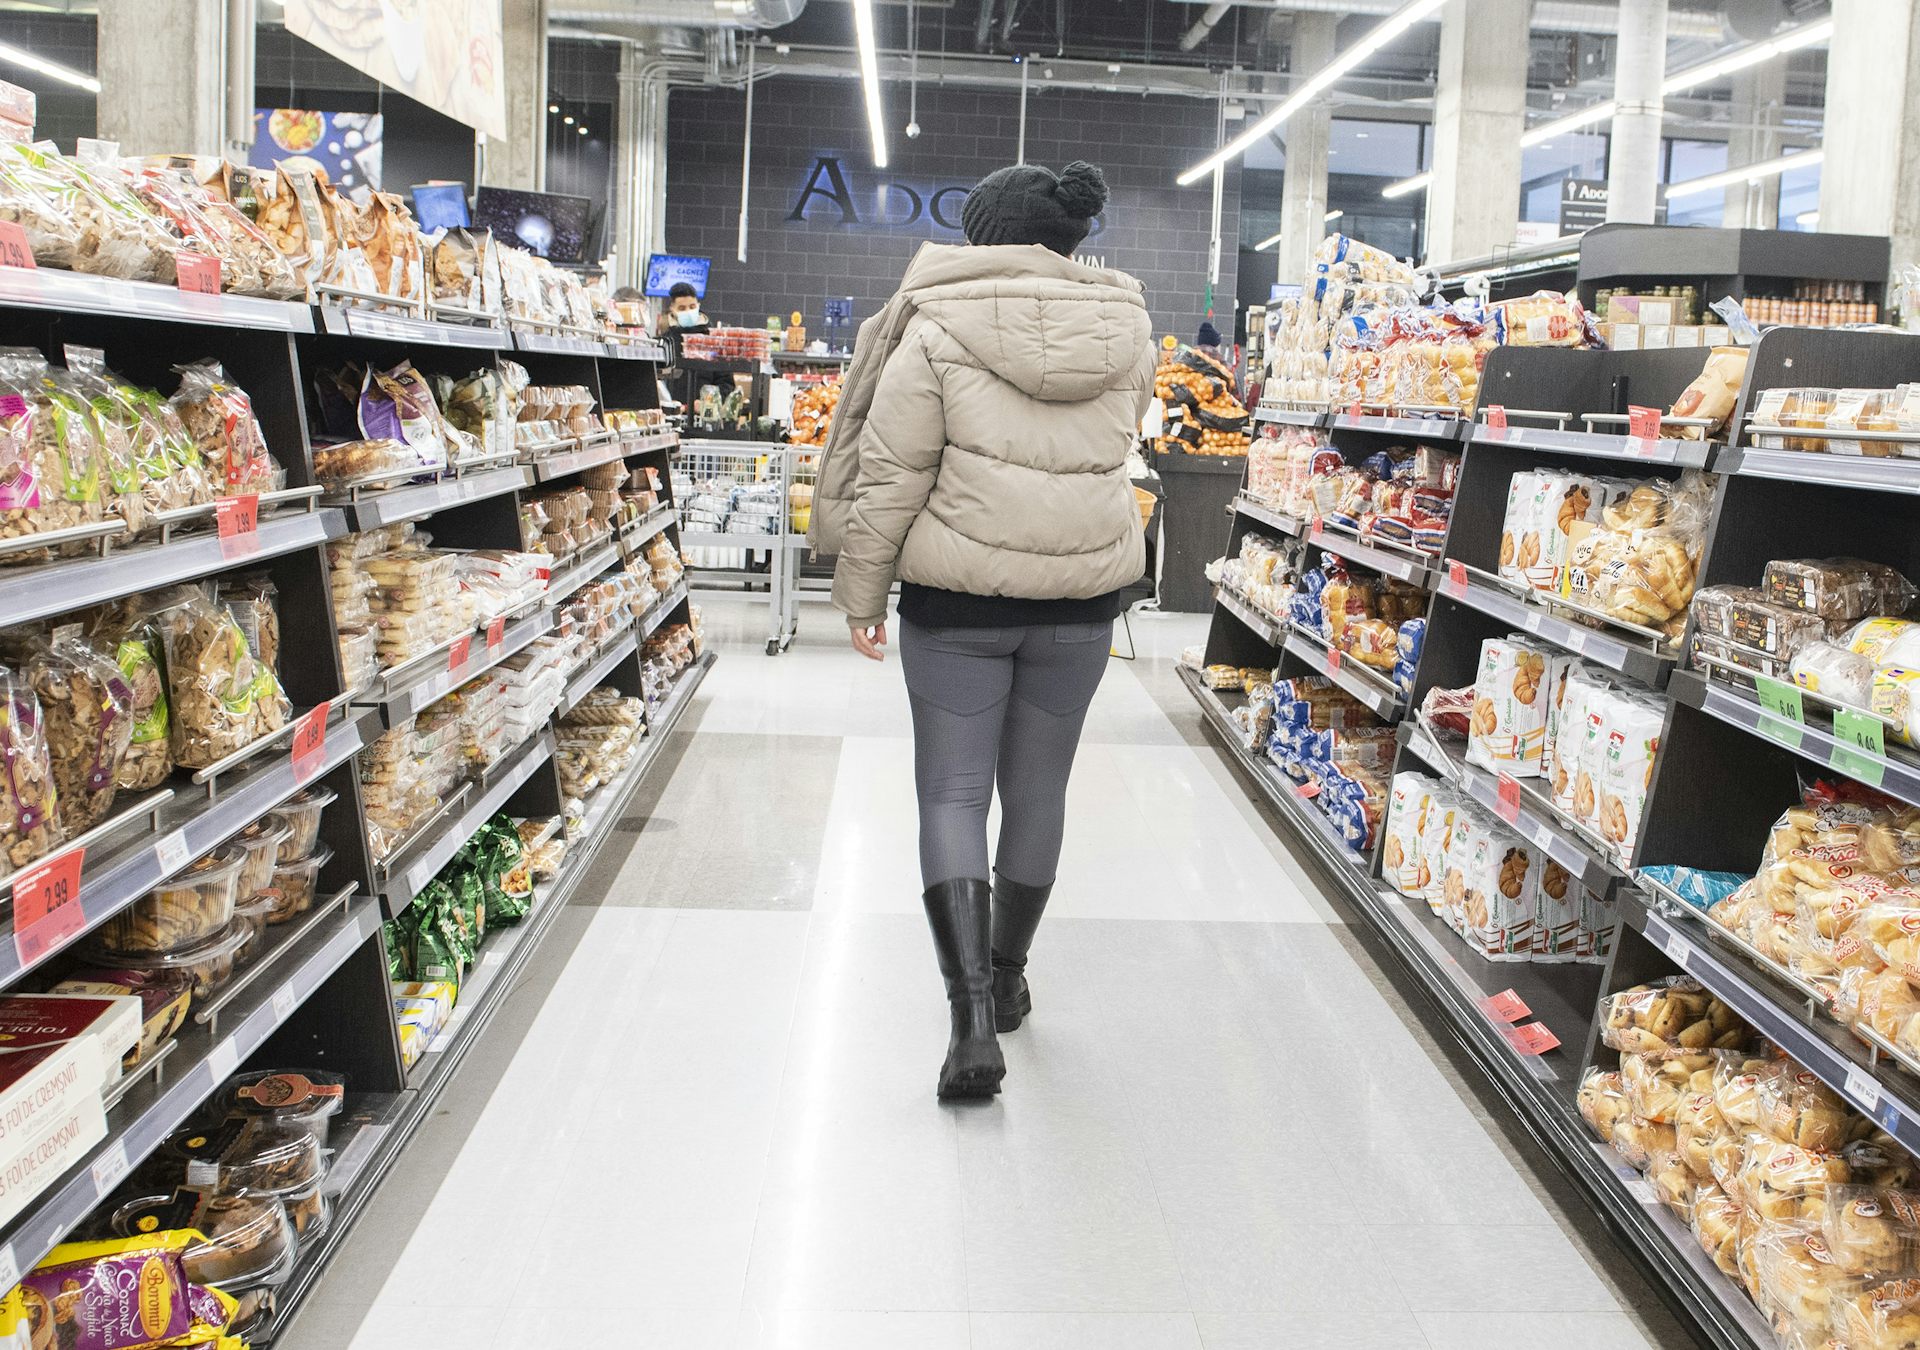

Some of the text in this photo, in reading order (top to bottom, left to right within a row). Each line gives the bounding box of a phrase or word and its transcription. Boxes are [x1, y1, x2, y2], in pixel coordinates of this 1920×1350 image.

[1779, 699, 1797, 721] 6.49
[45, 878, 68, 914] 2.99
[22, 1096, 35, 1120] DE
[23, 1153, 37, 1178] DE
[147, 1267, 164, 1330] Boromir
[82, 1291, 102, 1338] Stafide
